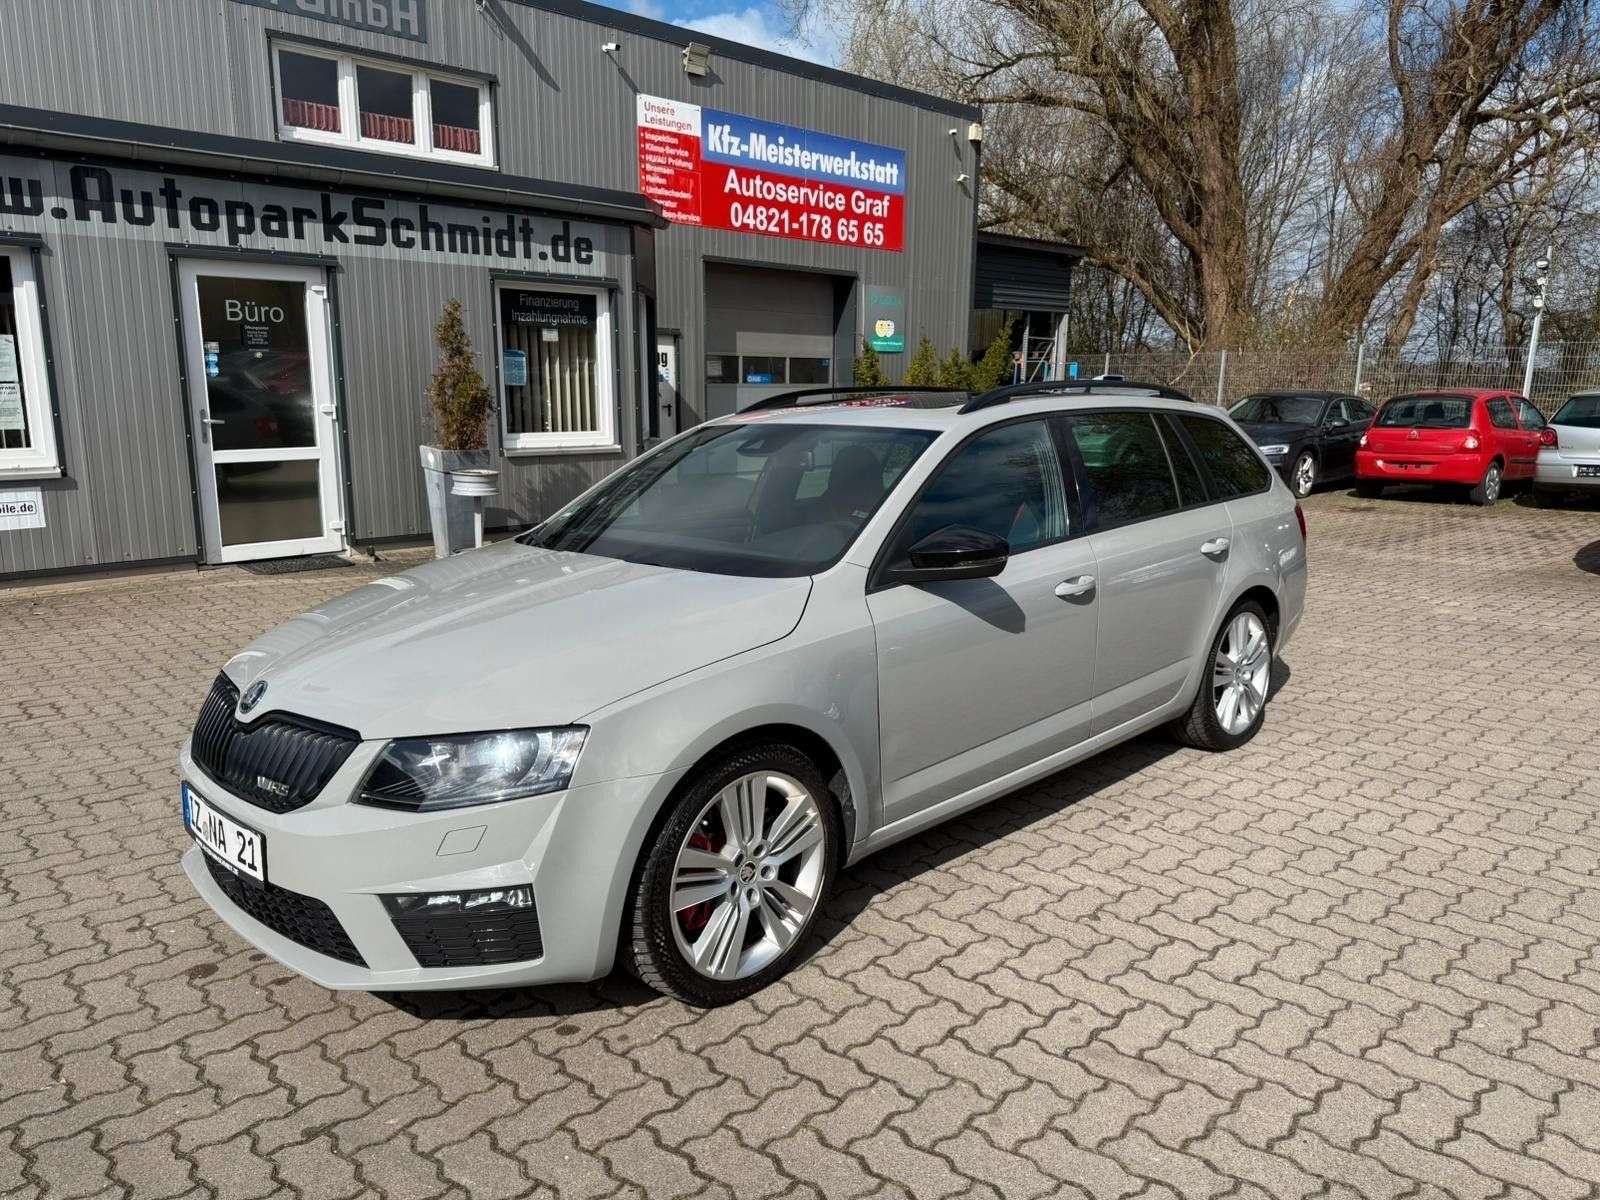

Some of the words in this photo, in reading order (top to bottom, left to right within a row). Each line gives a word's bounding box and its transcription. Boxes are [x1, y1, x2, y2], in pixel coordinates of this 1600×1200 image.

[644, 101, 675, 116] Unsere
[645, 113, 692, 131] Leistungen
[708, 123, 898, 185] Kfz-Meisterwerkstatt
[724, 168, 845, 210] Autoservice
[851, 190, 890, 218] Graf
[731, 201, 831, 239] 04821-178
[837, 220, 859, 243] 65
[863, 223, 884, 246] 65
[225, 299, 284, 323] Büro
[519, 294, 581, 311] Finanzierung
[511, 308, 589, 326] Inzahlungnahme
[236, 830, 258, 872] 21
